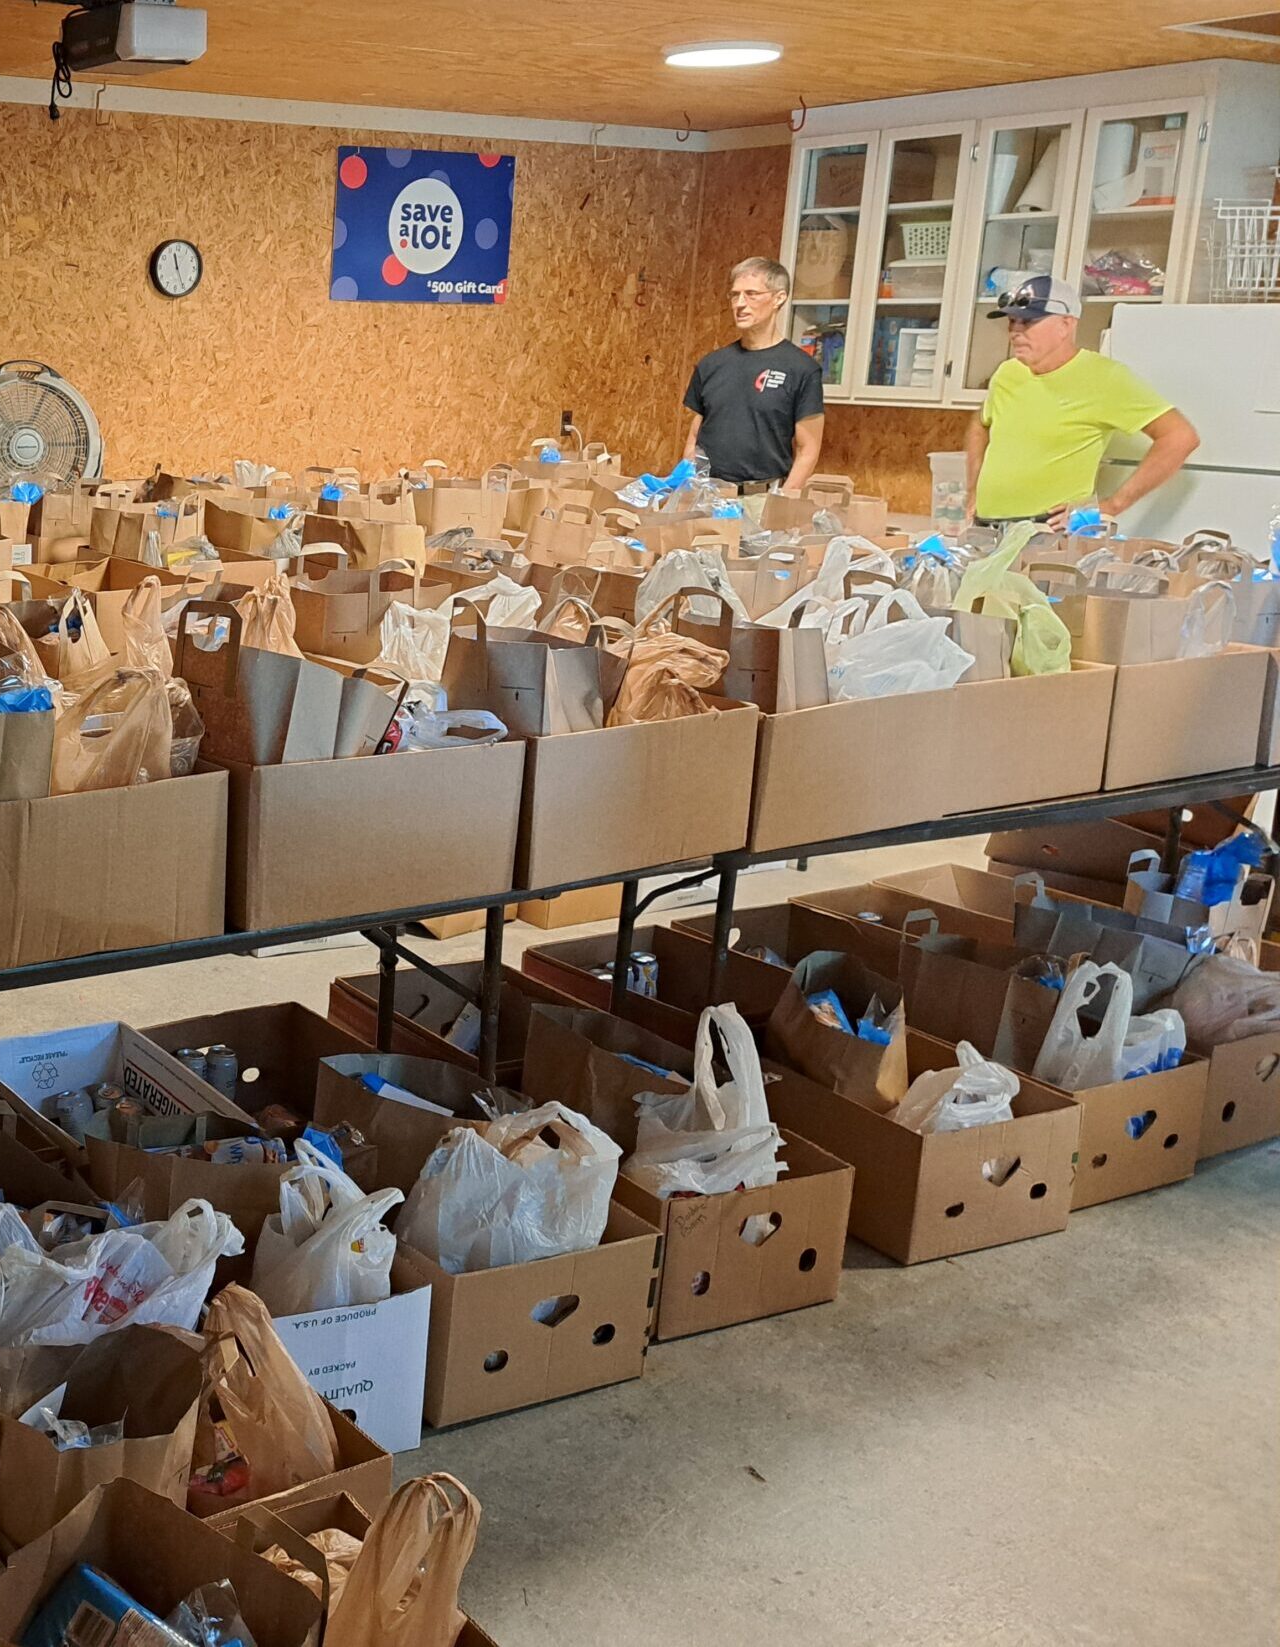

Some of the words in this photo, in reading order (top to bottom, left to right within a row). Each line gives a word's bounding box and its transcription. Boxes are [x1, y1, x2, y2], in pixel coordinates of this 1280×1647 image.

[400, 203, 454, 223] save
[399, 223, 410, 237] a
[411, 224, 452, 250] lot
[427, 280, 452, 293] $500
[454, 281, 477, 294] Gift
[477, 282, 504, 294] Card
[320, 1317, 333, 1326] OF
[334, 1308, 377, 1324] PRODUCE
[292, 1319, 319, 1330] U.S.A.
[308, 1368, 320, 1376] BY
[322, 1360, 356, 1374] PACKED
